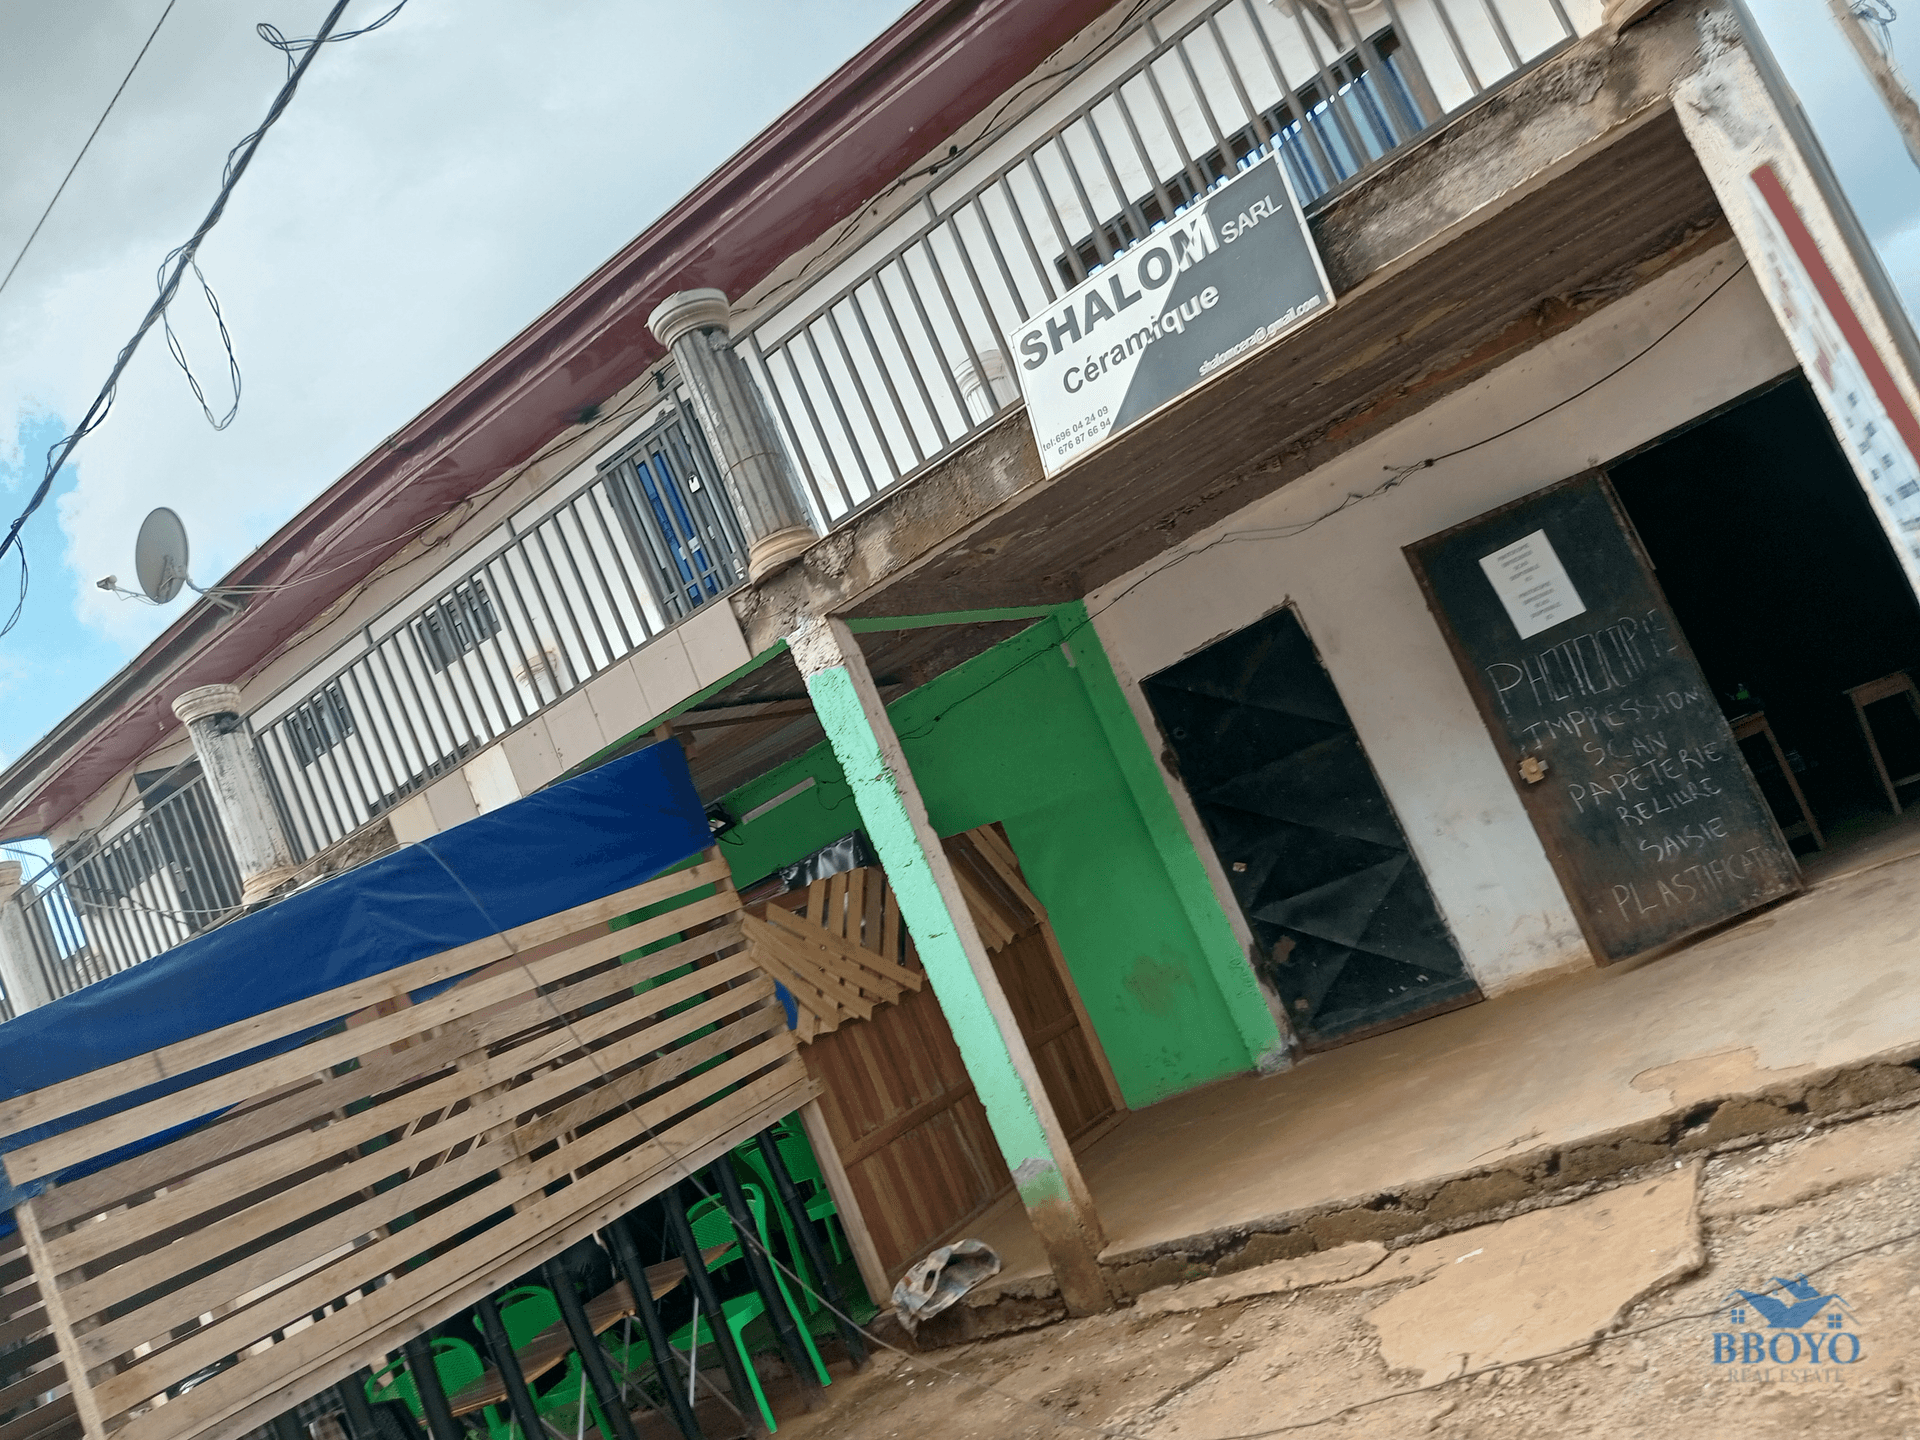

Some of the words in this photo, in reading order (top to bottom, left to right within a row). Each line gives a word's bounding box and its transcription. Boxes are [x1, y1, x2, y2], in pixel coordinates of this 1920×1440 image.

[1019, 211, 1219, 371] SHALOM
[1220, 195, 1283, 244] SARL
[1063, 285, 1220, 394] Céramique
[1058, 440, 1074, 455] 676
[1074, 432, 1085, 445] 87
[1087, 425, 1099, 437] 66
[1099, 417, 1111, 430] 94
[1072, 420, 1084, 433] 04
[1084, 413, 1096, 426] 24
[1097, 405, 1109, 418] 09
[1521, 685, 1703, 751] IMPRESSION
[1583, 731, 1668, 766] SCAN
[1568, 742, 1723, 814] PAPETERIE
[1616, 777, 1722, 827] RELIURE
[1639, 816, 1728, 863] SAISIE
